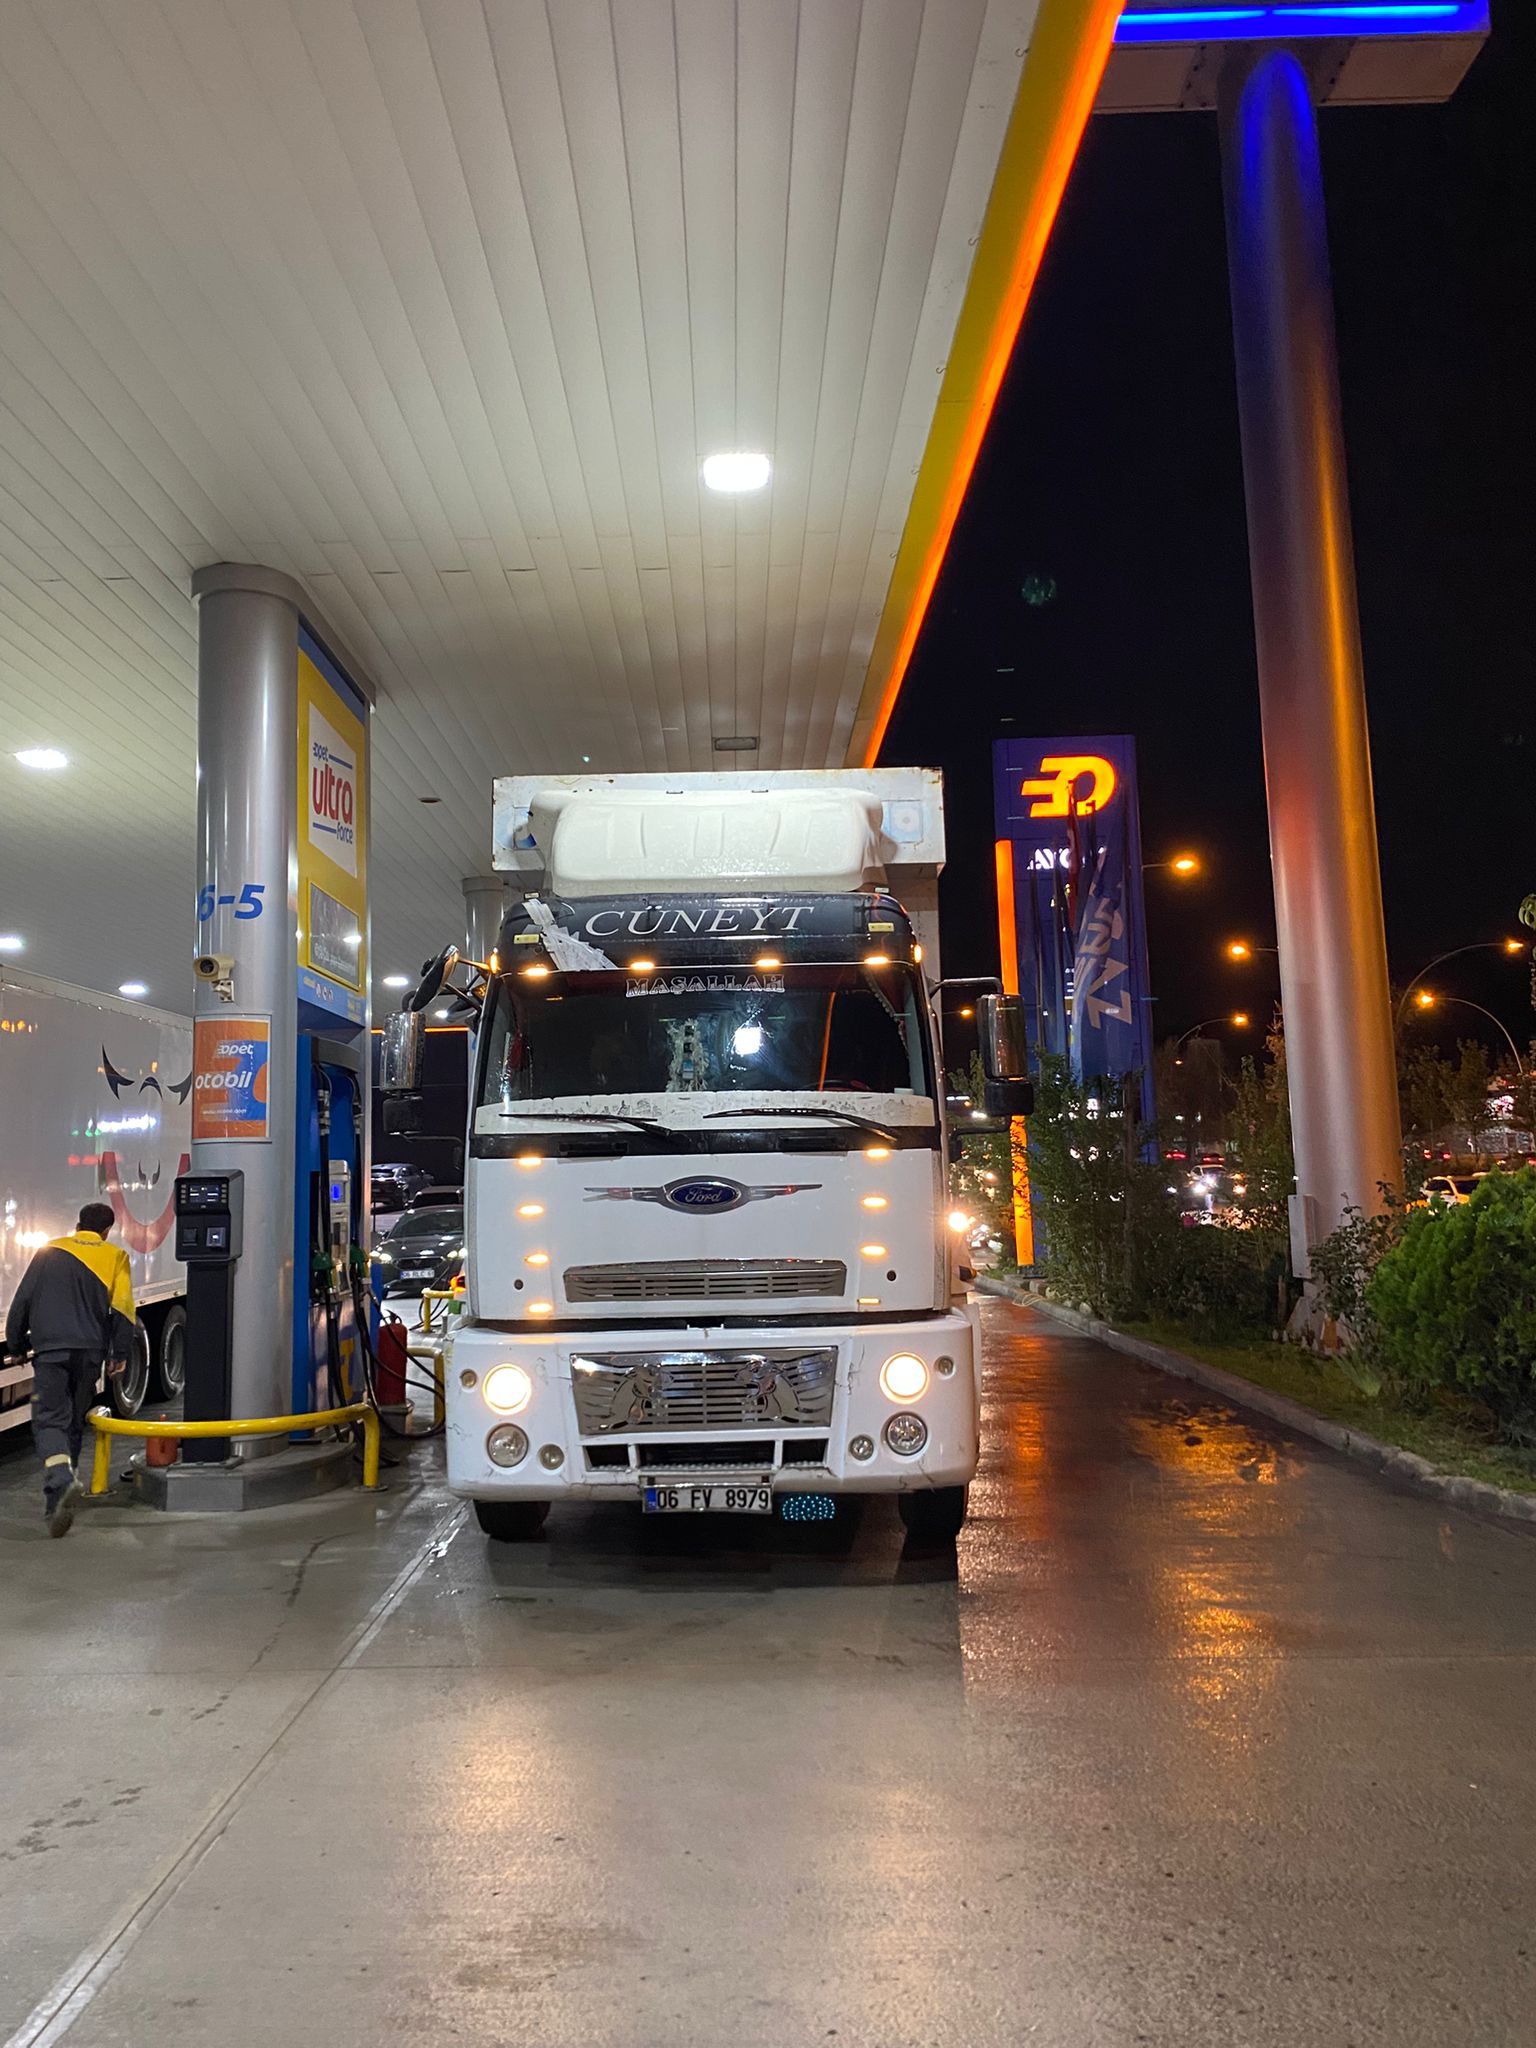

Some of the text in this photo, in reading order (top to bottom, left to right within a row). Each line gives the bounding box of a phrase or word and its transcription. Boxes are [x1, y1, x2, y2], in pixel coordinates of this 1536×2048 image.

[313, 763, 353, 825] ultra
[336, 822, 353, 844] force
[197, 884, 265, 922] 6-5
[585, 905, 815, 937] CÜNEYT
[626, 974, 785, 998] MAŞALLAH
[195, 1071, 252, 1089] otobil
[685, 1187, 722, 1203] Ford
[657, 1488, 769, 1509] 06 FV 8979
